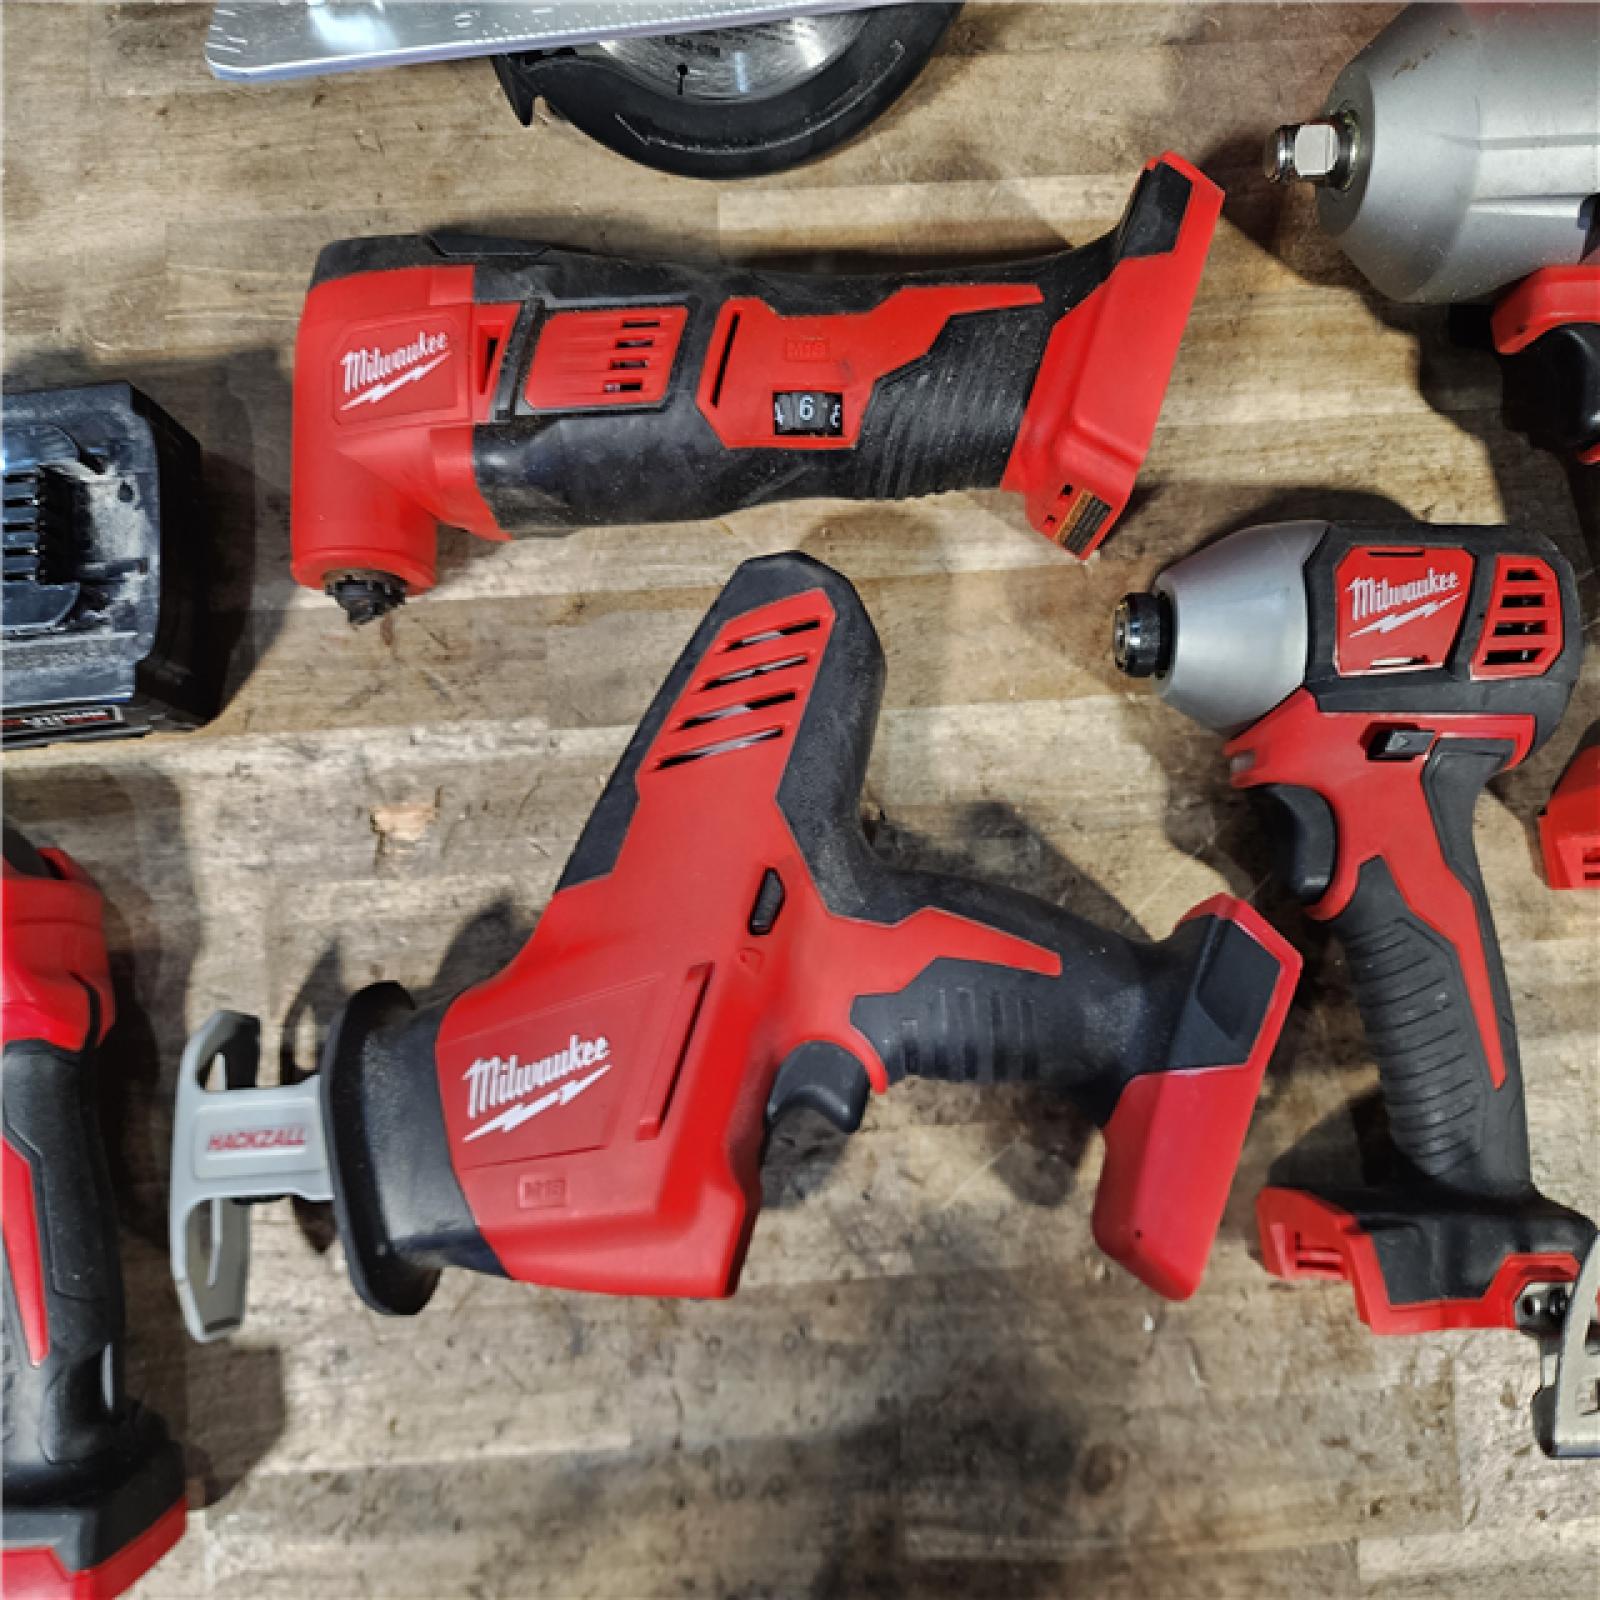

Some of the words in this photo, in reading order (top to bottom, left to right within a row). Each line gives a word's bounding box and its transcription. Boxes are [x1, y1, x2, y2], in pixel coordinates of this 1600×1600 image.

[340, 330, 448, 394] Milwaukee
[799, 395, 815, 421] 6
[1345, 567, 1460, 621] Milwaukee
[462, 1034, 611, 1120] Milwaukee
[207, 1128, 305, 1151] HACKZALL
